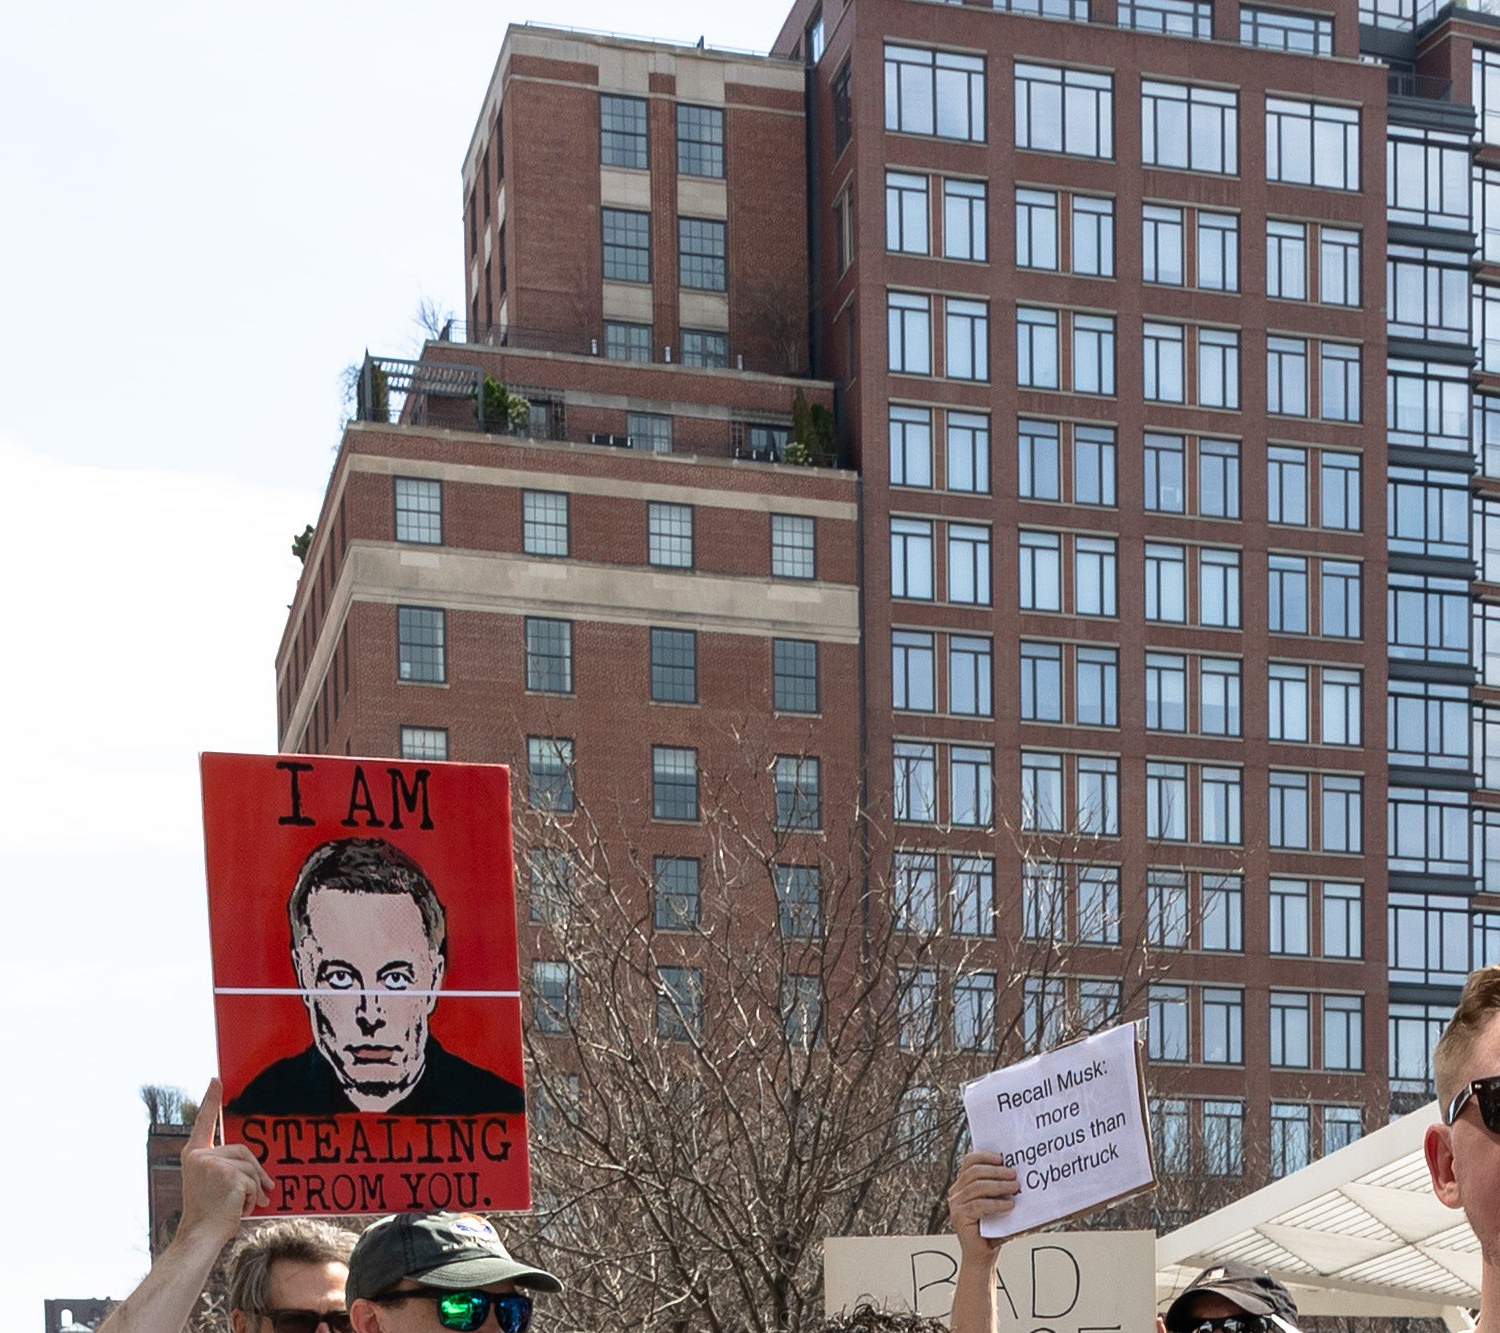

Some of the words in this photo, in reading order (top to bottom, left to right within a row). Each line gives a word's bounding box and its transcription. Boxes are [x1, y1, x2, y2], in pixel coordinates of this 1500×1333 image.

[277, 761, 316, 827] I
[341, 765, 434, 830] AM
[996, 1078, 1053, 1112] Recall
[1057, 1060, 1108, 1092] Musk:
[1036, 1102, 1080, 1130] more
[1090, 1111, 1126, 1138] than
[241, 1118, 512, 1165] STEALING
[1026, 1142, 1120, 1191] Cybertruck
[274, 1173, 387, 1211] FROM
[400, 1172, 492, 1209] YOU.
